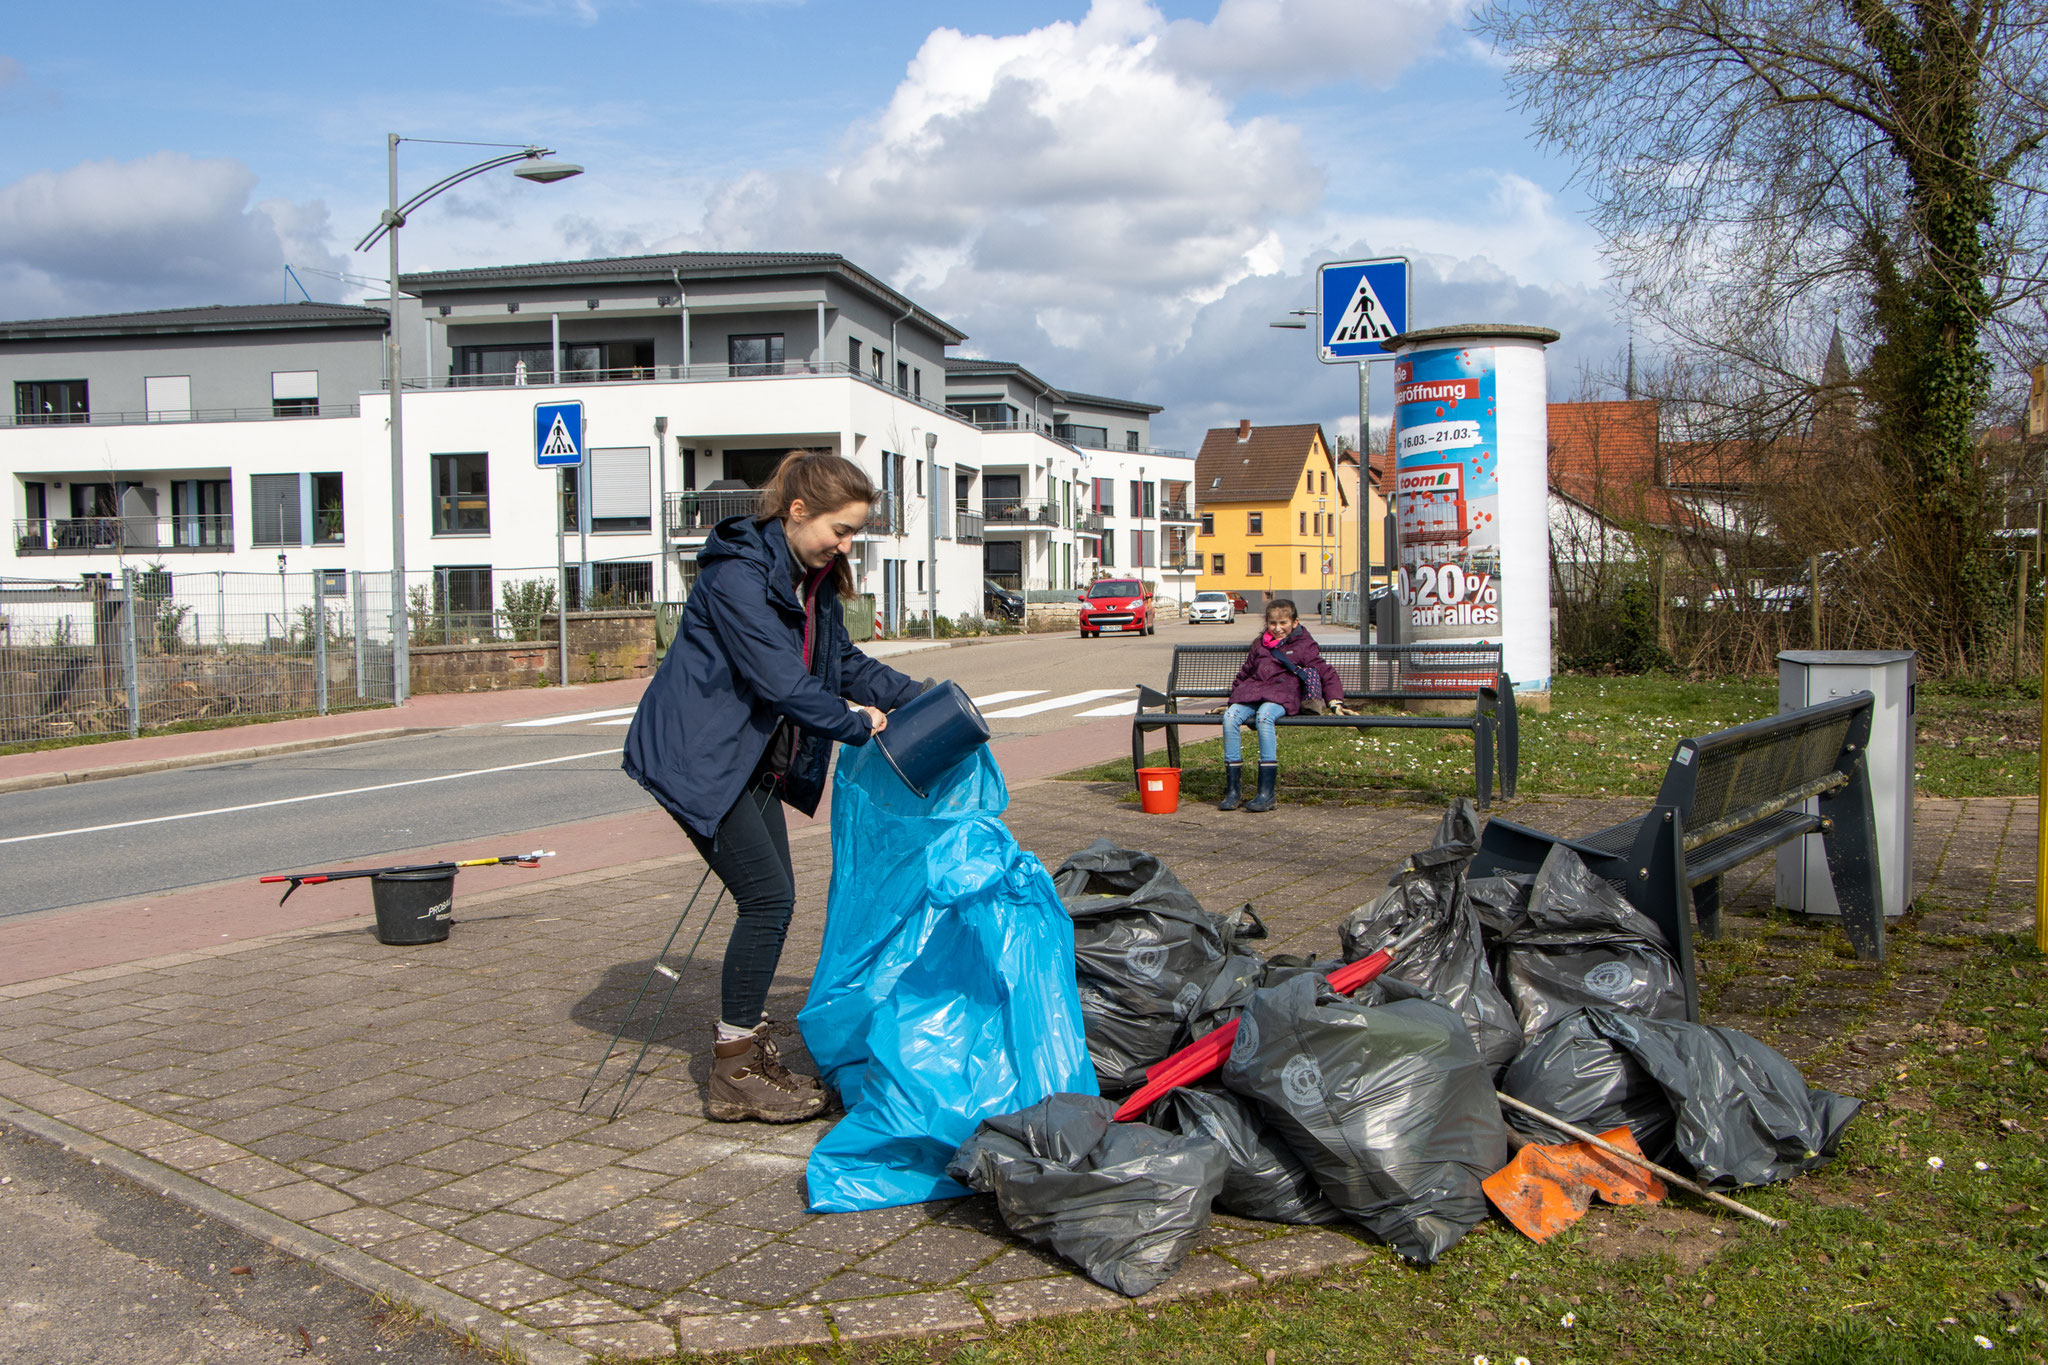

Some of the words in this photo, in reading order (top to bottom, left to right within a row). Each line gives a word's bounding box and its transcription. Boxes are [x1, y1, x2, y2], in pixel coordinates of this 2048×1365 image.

[1396, 384, 1466, 404] eröffnung
[1400, 475, 1436, 489] toom
[1412, 604, 1440, 626] auf
[1444, 602, 1499, 626] alles
